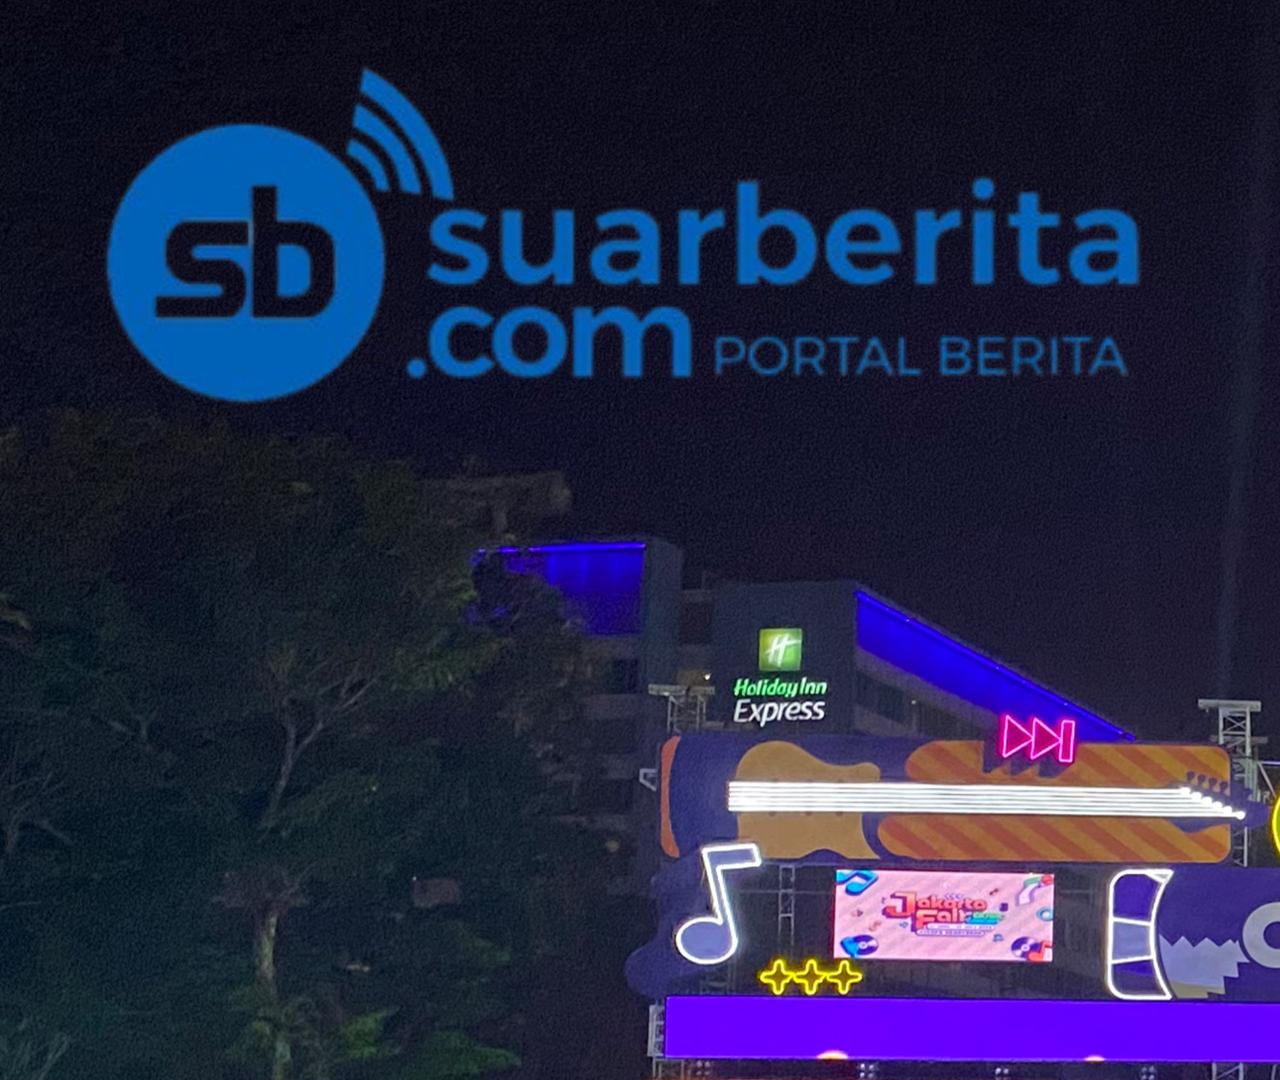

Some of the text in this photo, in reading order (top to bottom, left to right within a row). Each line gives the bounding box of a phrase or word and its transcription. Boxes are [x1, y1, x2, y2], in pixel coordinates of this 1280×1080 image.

[734, 676, 828, 698] Holiday Inn
[733, 698, 826, 728] Express
[882, 891, 988, 919] Jakarta
